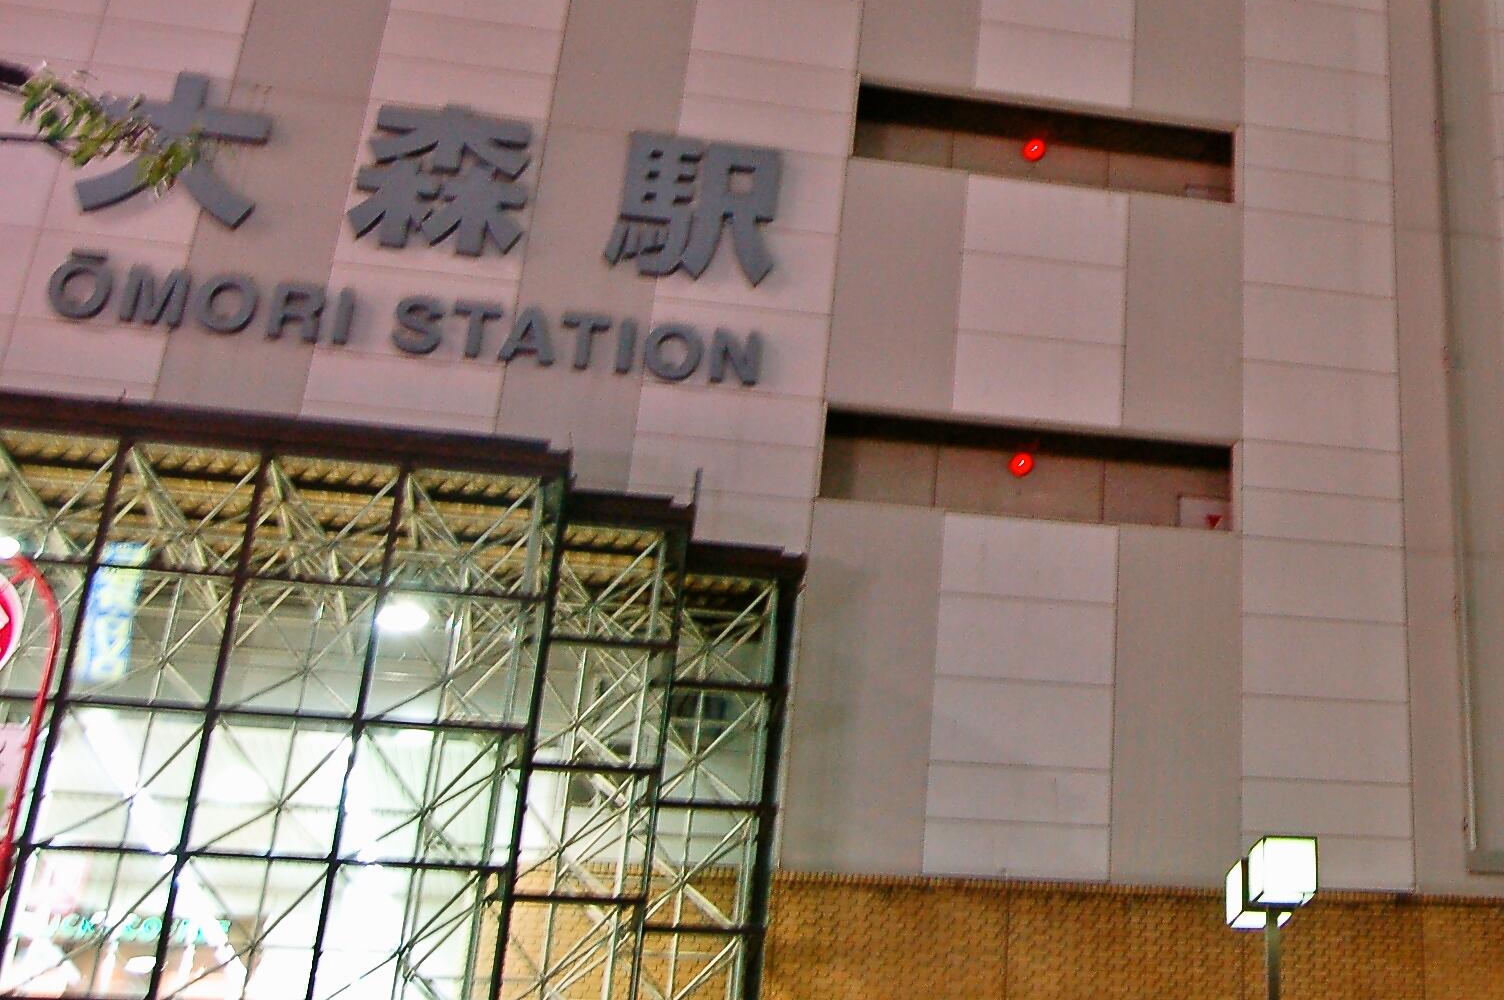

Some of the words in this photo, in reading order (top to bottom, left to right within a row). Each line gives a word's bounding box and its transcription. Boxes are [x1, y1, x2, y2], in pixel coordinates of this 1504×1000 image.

[75, 71, 786, 288] 大森駅
[48, 249, 359, 346] ŌMORI
[390, 293, 764, 387] STATION
